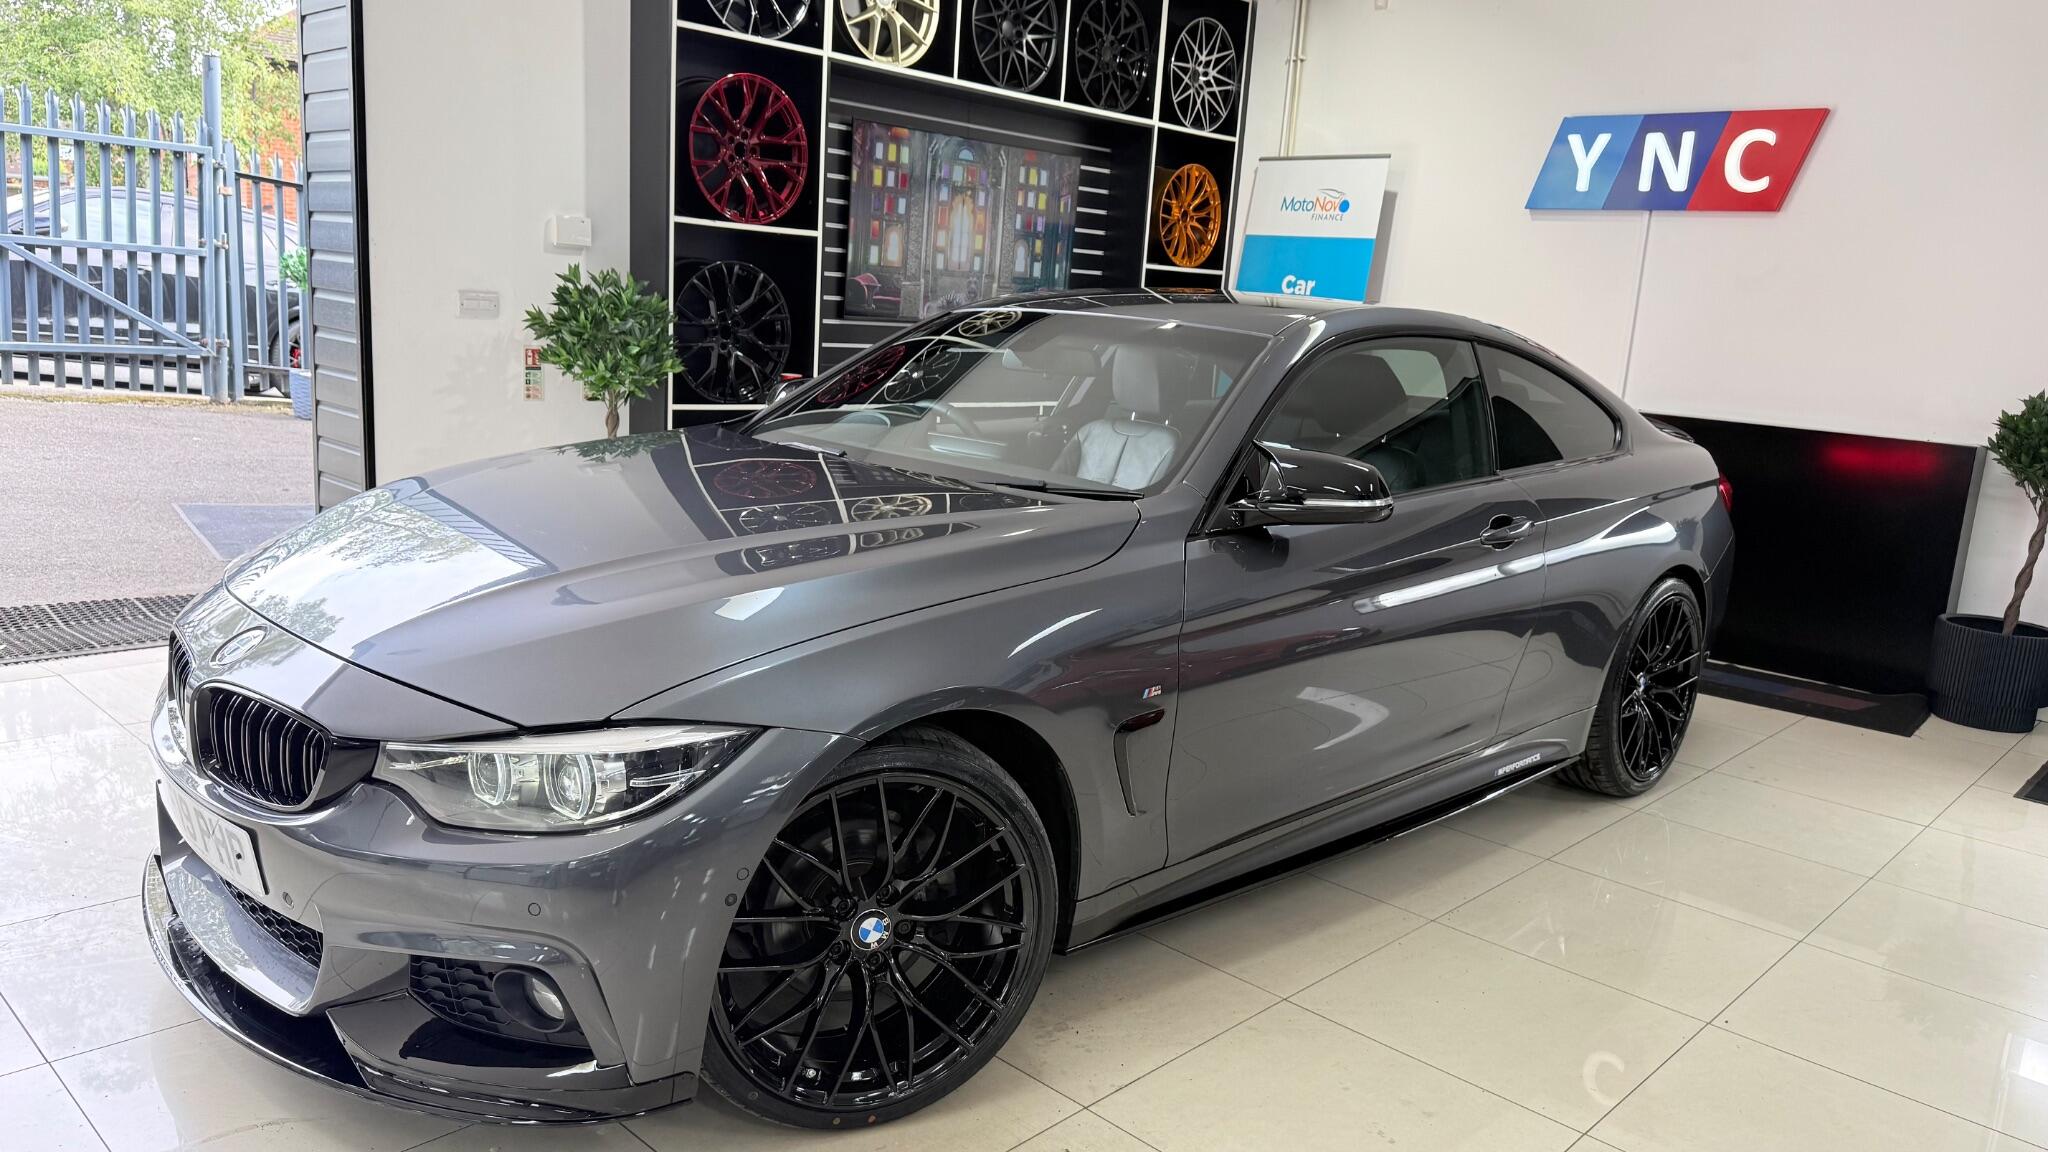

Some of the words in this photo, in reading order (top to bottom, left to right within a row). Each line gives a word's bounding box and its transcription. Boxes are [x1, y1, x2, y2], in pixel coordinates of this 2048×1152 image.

[1567, 128, 1777, 193] YNC
[1311, 213, 1345, 222] FINANCE
[1281, 274, 1316, 296] Car
